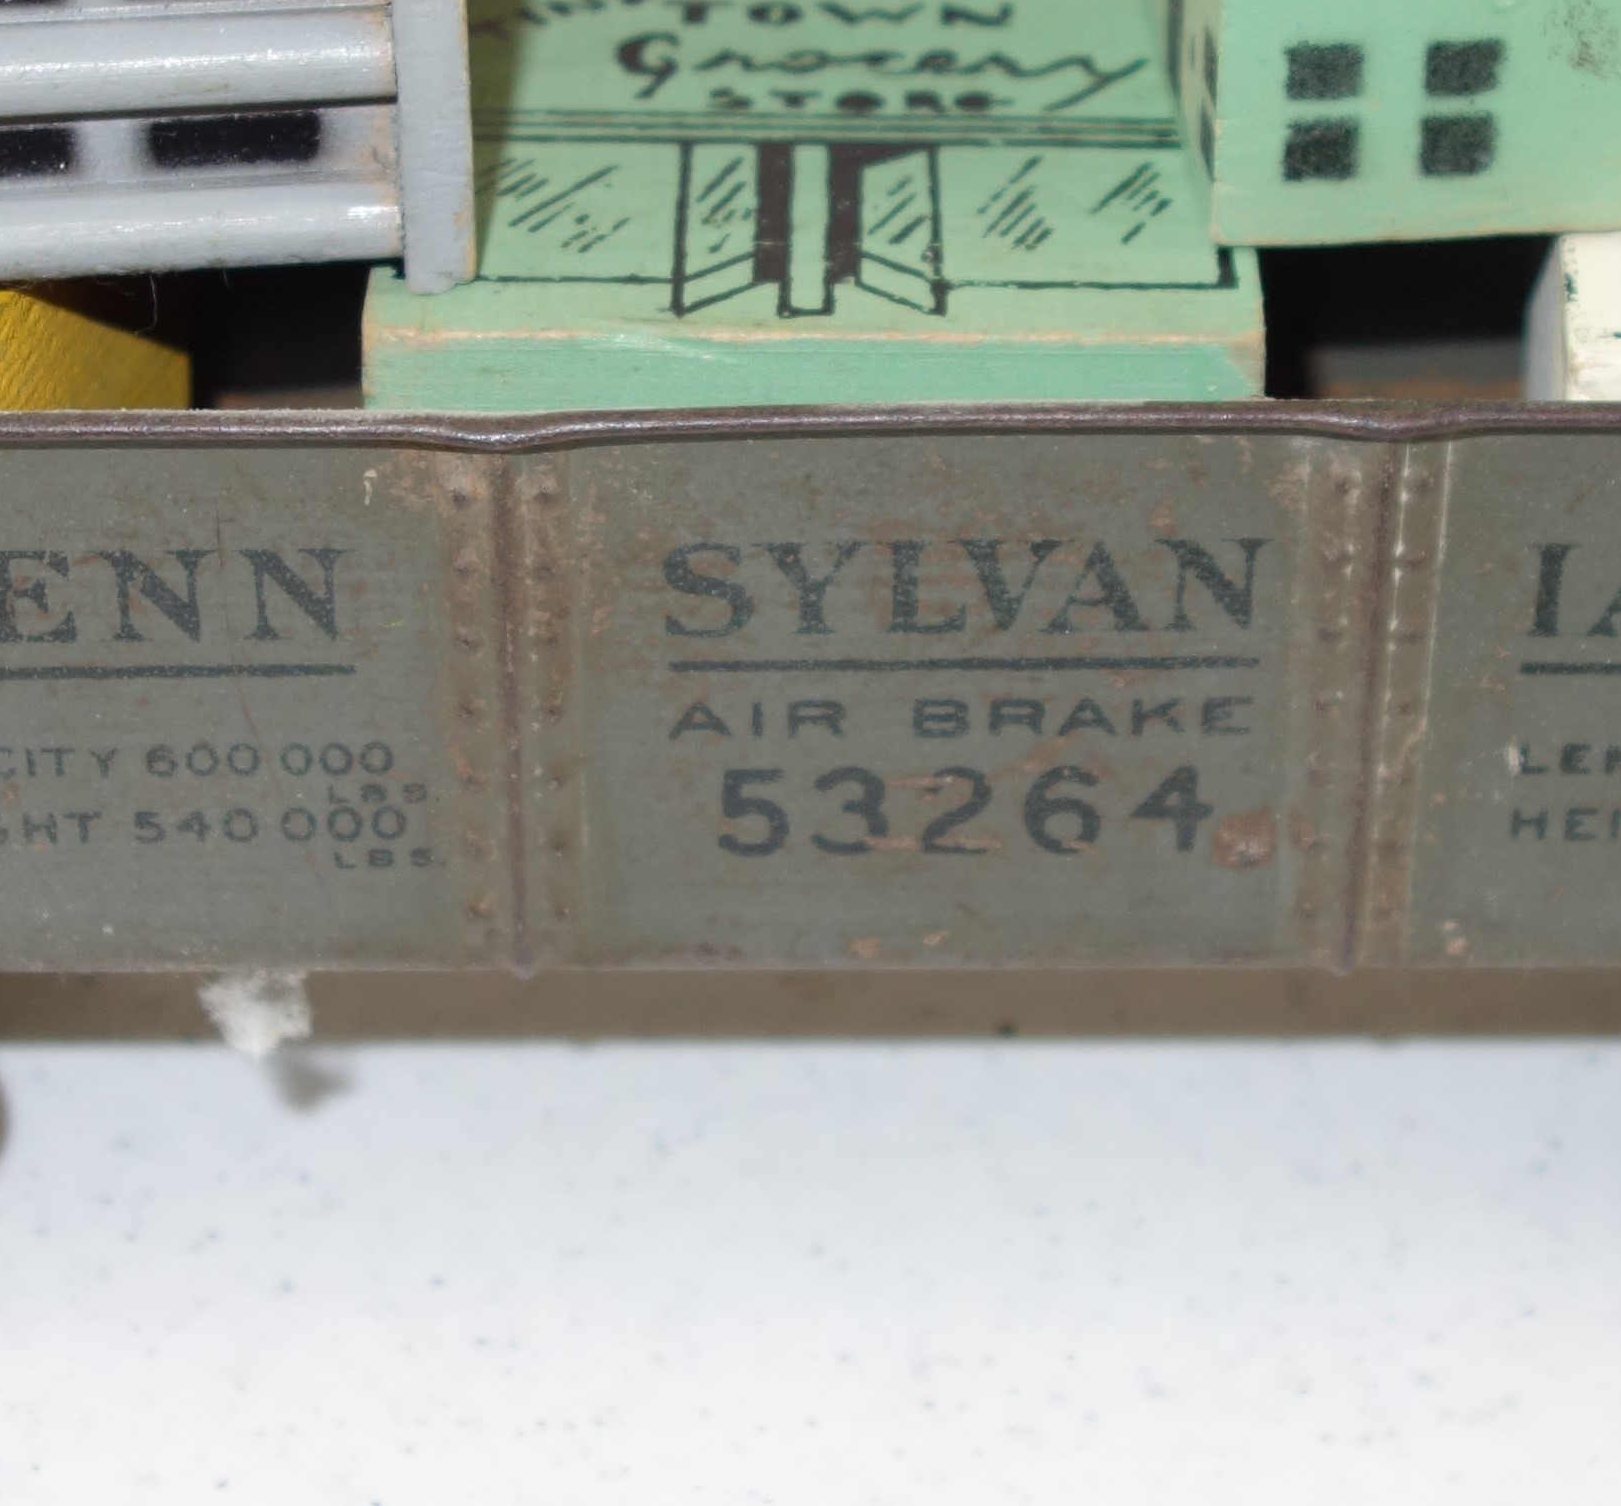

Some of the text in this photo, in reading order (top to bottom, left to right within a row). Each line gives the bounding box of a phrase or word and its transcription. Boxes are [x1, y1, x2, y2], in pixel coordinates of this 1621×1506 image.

[613, 28, 1149, 112] Grocery
[662, 536, 1276, 640] SYLVAN
[667, 696, 1255, 741] AIR BRAKE
[717, 764, 1214, 859] 53264
